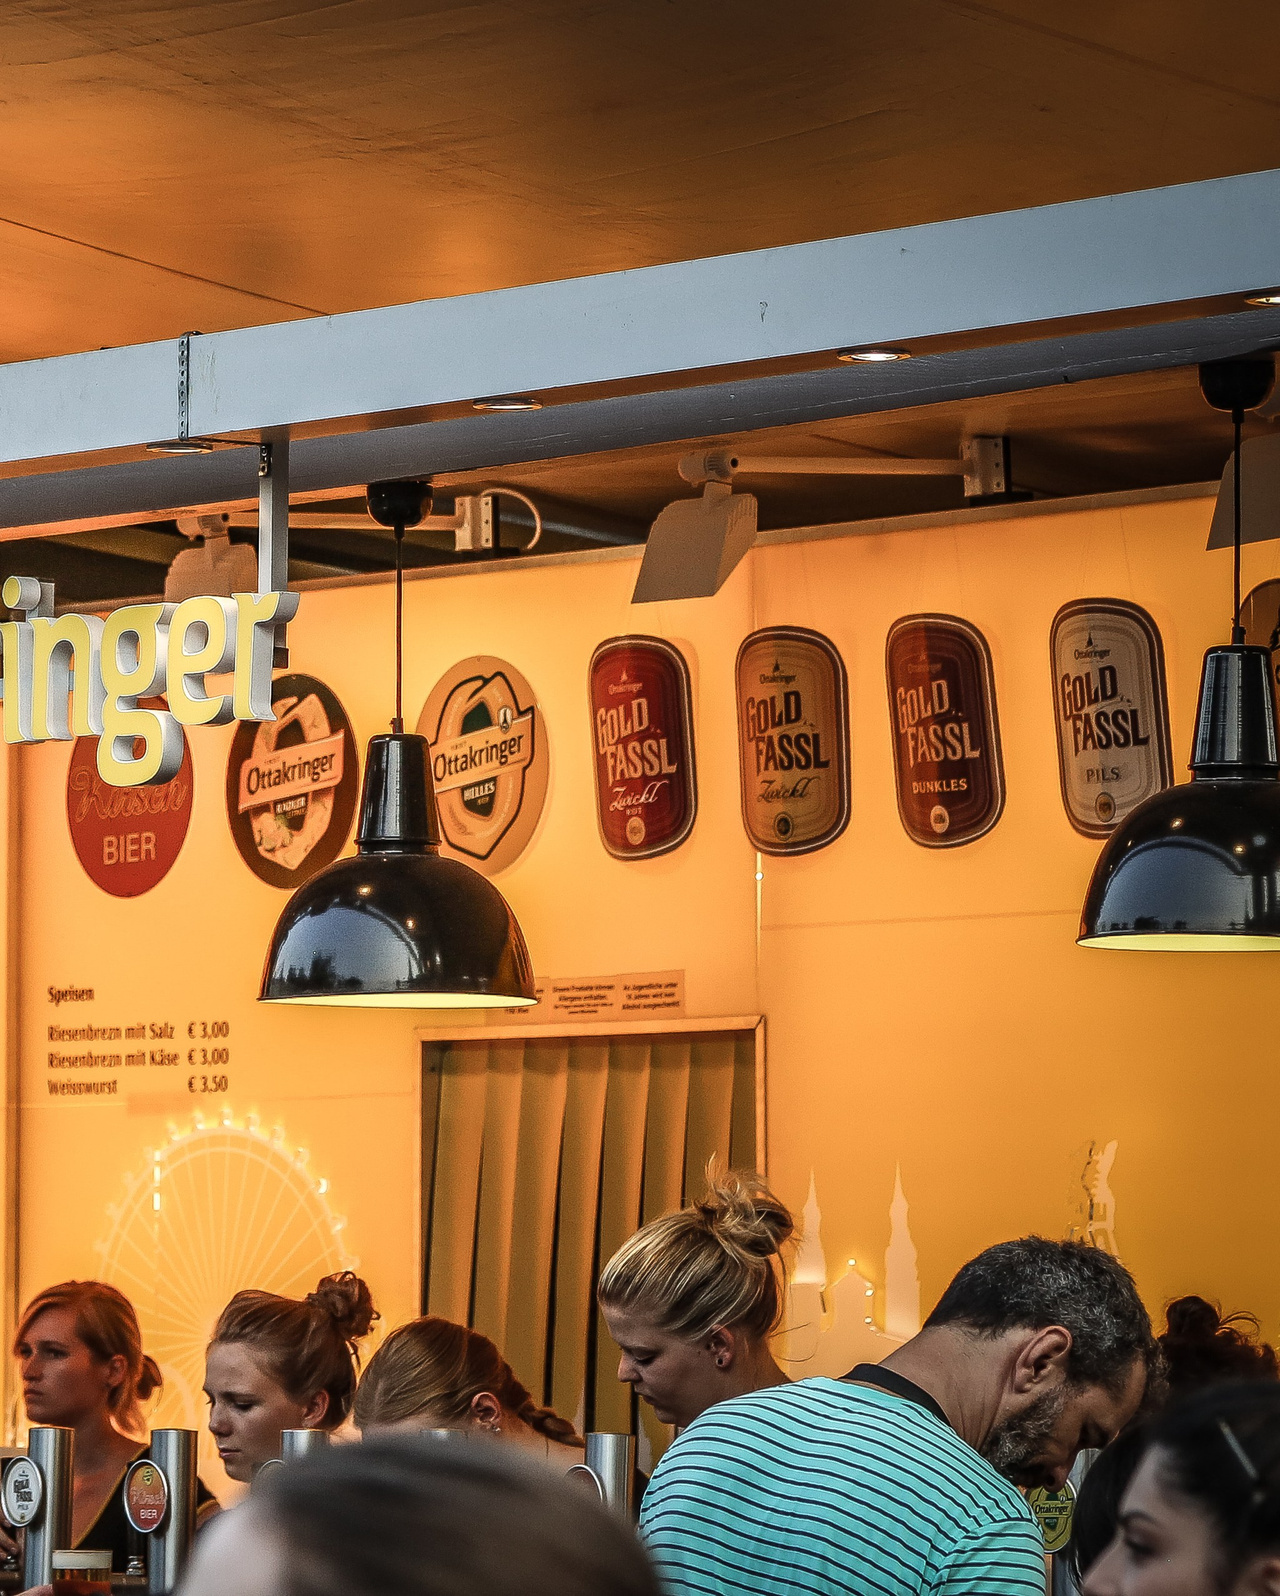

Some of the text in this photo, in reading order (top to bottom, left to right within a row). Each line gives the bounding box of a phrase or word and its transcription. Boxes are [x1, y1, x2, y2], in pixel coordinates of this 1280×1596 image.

[896, 679, 949, 734] GOLD
[1061, 664, 1118, 721] GOLD
[596, 698, 649, 754] GOLD
[745, 690, 802, 742] GOLD
[1073, 708, 1150, 757] FASSL
[434, 734, 524, 782] Ottakringer
[604, 738, 677, 787] FASSL
[756, 733, 830, 777] FASSL
[907, 722, 981, 769] FASSL
[247, 753, 336, 795] Ottakringer
[463, 781, 496, 802] HELLES
[912, 778, 968, 795] DUNKLES
[1086, 766, 1120, 784] PILS
[102, 831, 157, 866] BIER
[47, 985, 95, 1007] Speisen
[48, 1020, 230, 1042] Riesenbrezn mit Salz € 3,00
[48, 1047, 230, 1069] Riesenbrezn mit Käse € 3,00
[47, 1074, 229, 1096] Weisswurst € 3,50
